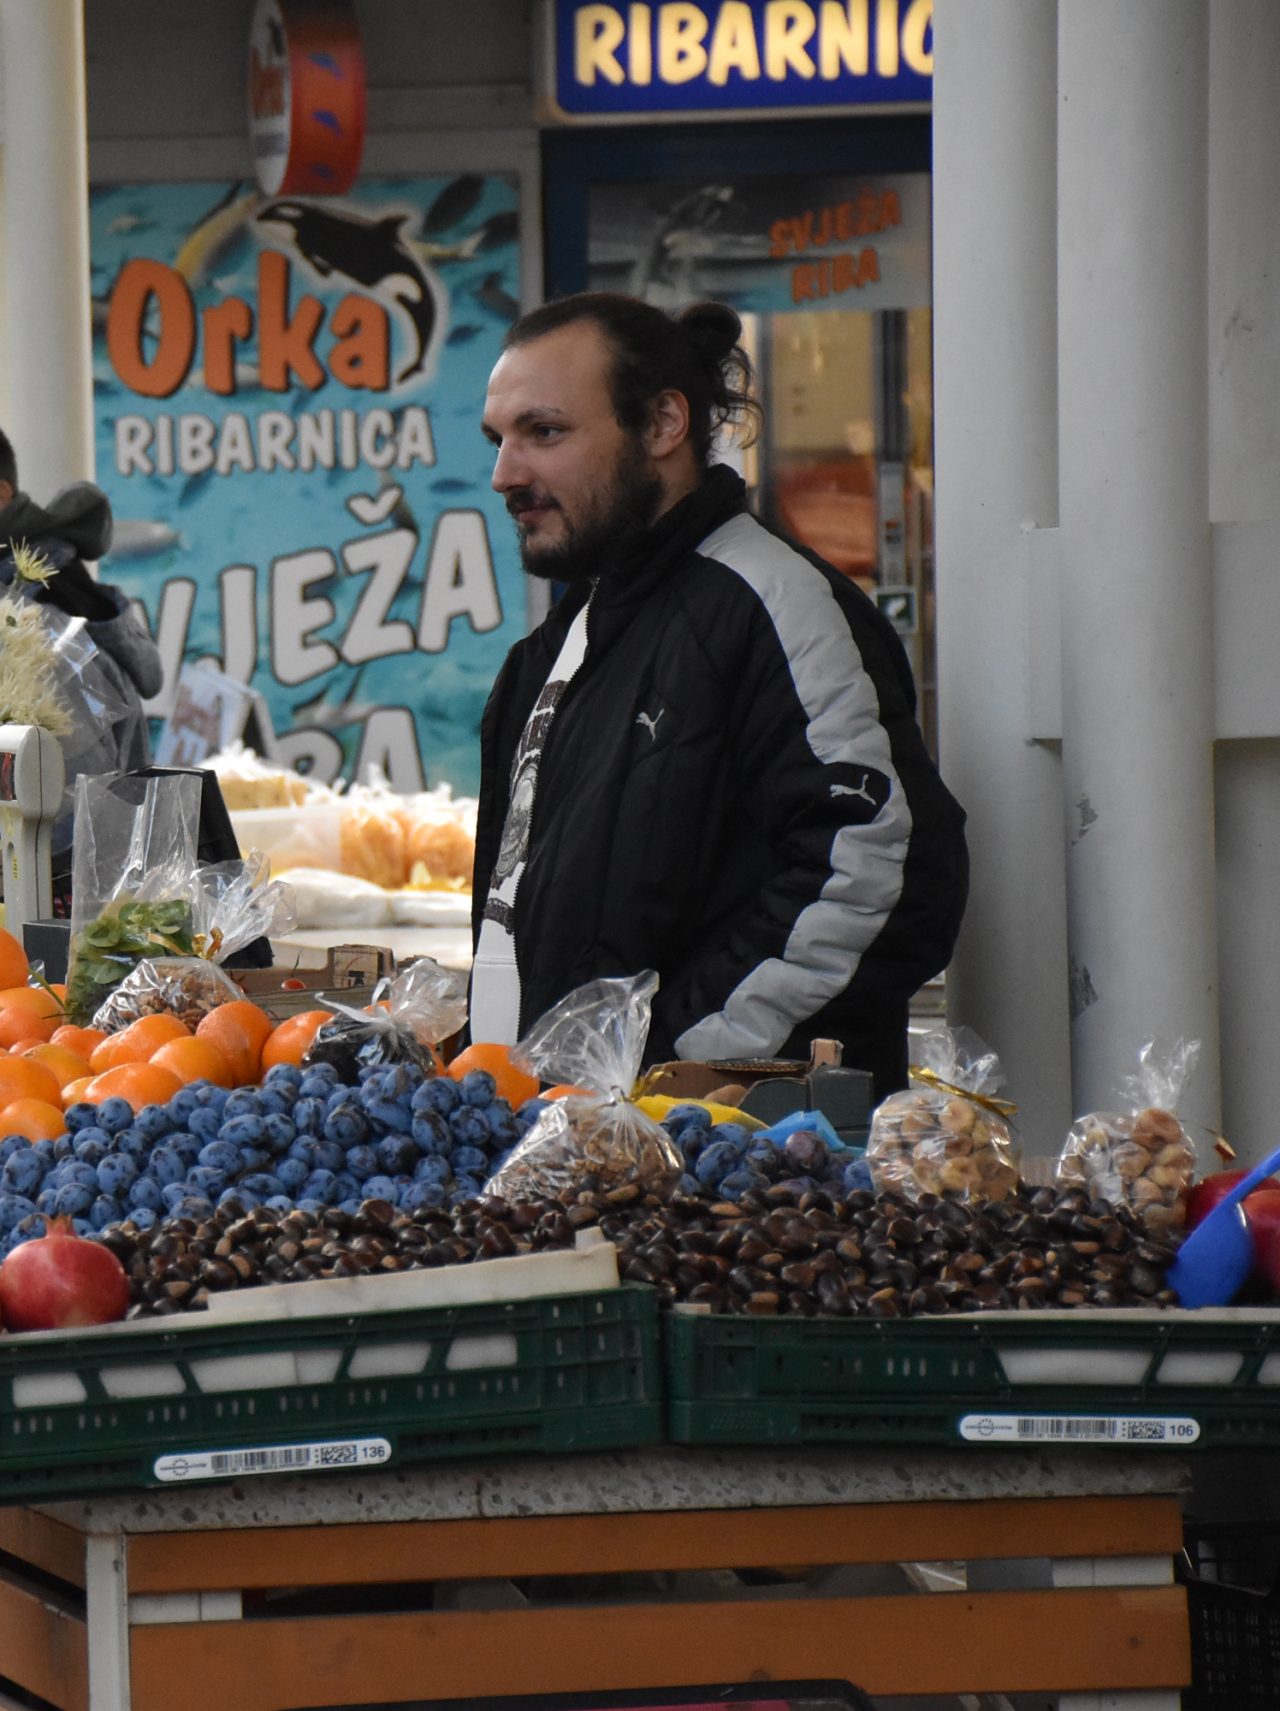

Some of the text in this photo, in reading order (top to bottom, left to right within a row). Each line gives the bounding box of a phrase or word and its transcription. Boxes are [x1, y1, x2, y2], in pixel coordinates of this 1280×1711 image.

[574, 0, 933, 87] RIBARNIC
[792, 244, 881, 306] RIBA
[106, 250, 393, 398] Orka
[115, 406, 437, 476] RIBARNICA
[361, 1445, 386, 1459] 136
[1169, 1424, 1194, 1437] 106
